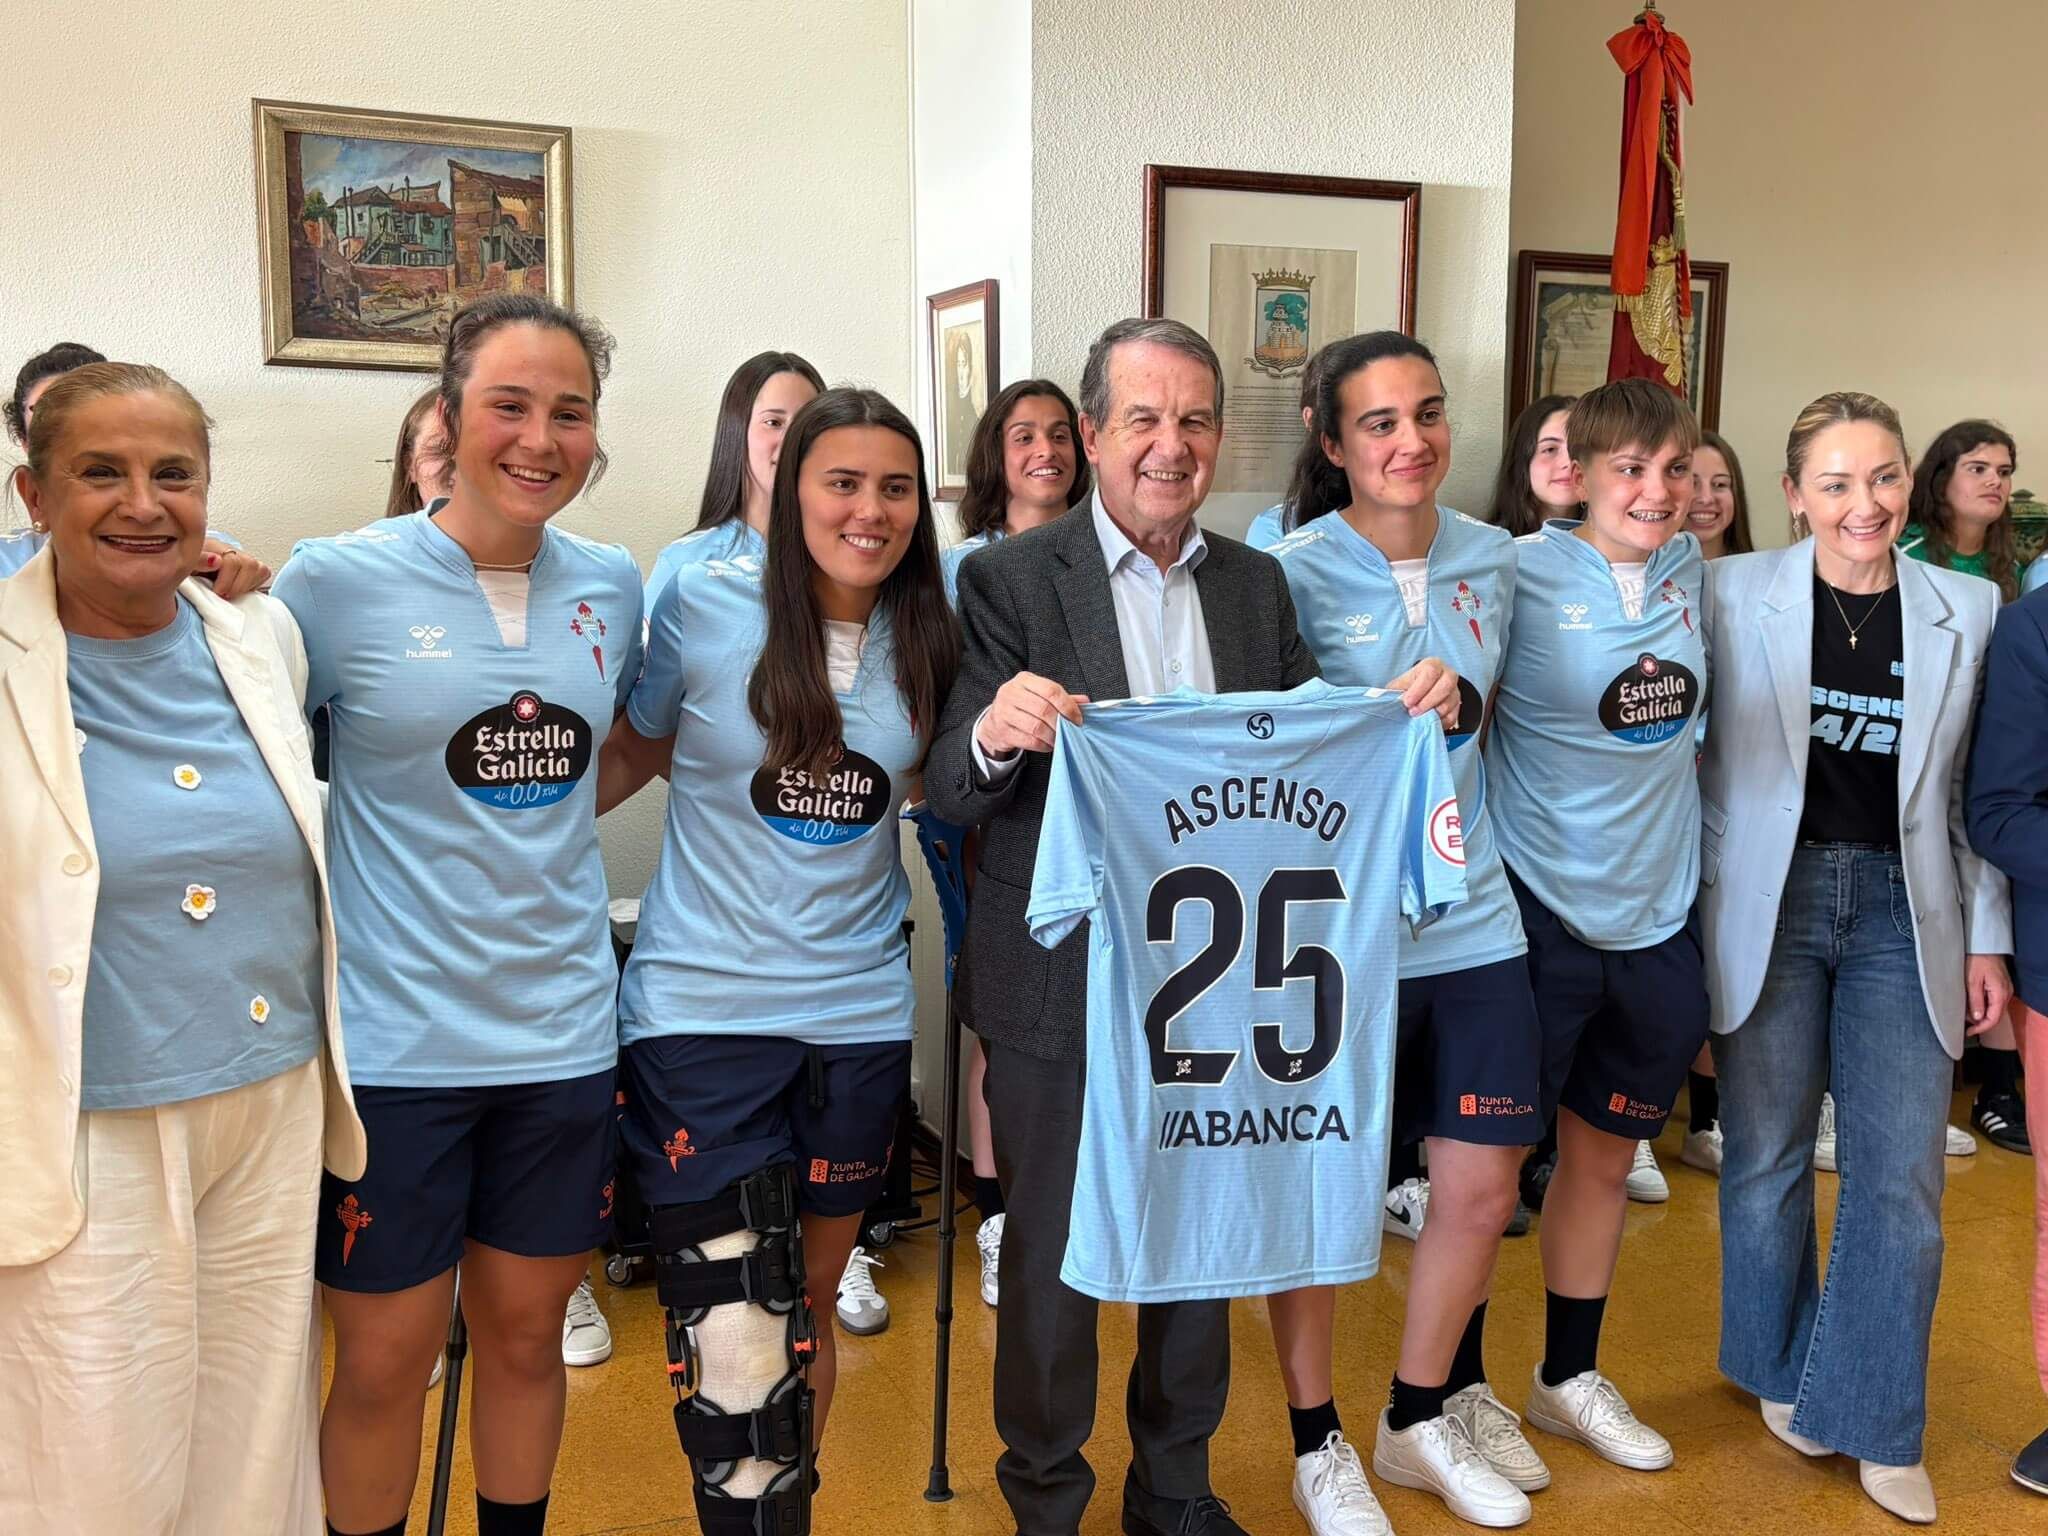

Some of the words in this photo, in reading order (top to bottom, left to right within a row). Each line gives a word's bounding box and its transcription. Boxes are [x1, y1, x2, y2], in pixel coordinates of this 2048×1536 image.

[405, 648, 452, 658] hummel
[1618, 675, 1686, 703] Estrella
[1619, 696, 1682, 724] Galicia
[1810, 685, 1904, 720] SCENS
[473, 724, 576, 753] Estrella
[1810, 713, 1900, 755] 4/2
[476, 751, 570, 781] Galicia
[510, 780, 541, 805] 0,0
[777, 787, 864, 819] Galicia
[1163, 776, 1348, 846] ASCENSO
[803, 818, 834, 841] 0,0
[1448, 834, 1463, 849] E
[1144, 864, 1348, 1087] 25
[1479, 1096, 1514, 1106] XUNTA
[1479, 1105, 1493, 1115] DE
[1493, 1104, 1534, 1116] GALICIA
[1625, 1107, 1639, 1118] DE
[1628, 1099, 1659, 1112] XUNTA
[829, 1173, 845, 1183] DE
[831, 1161, 866, 1172] XUNTA
